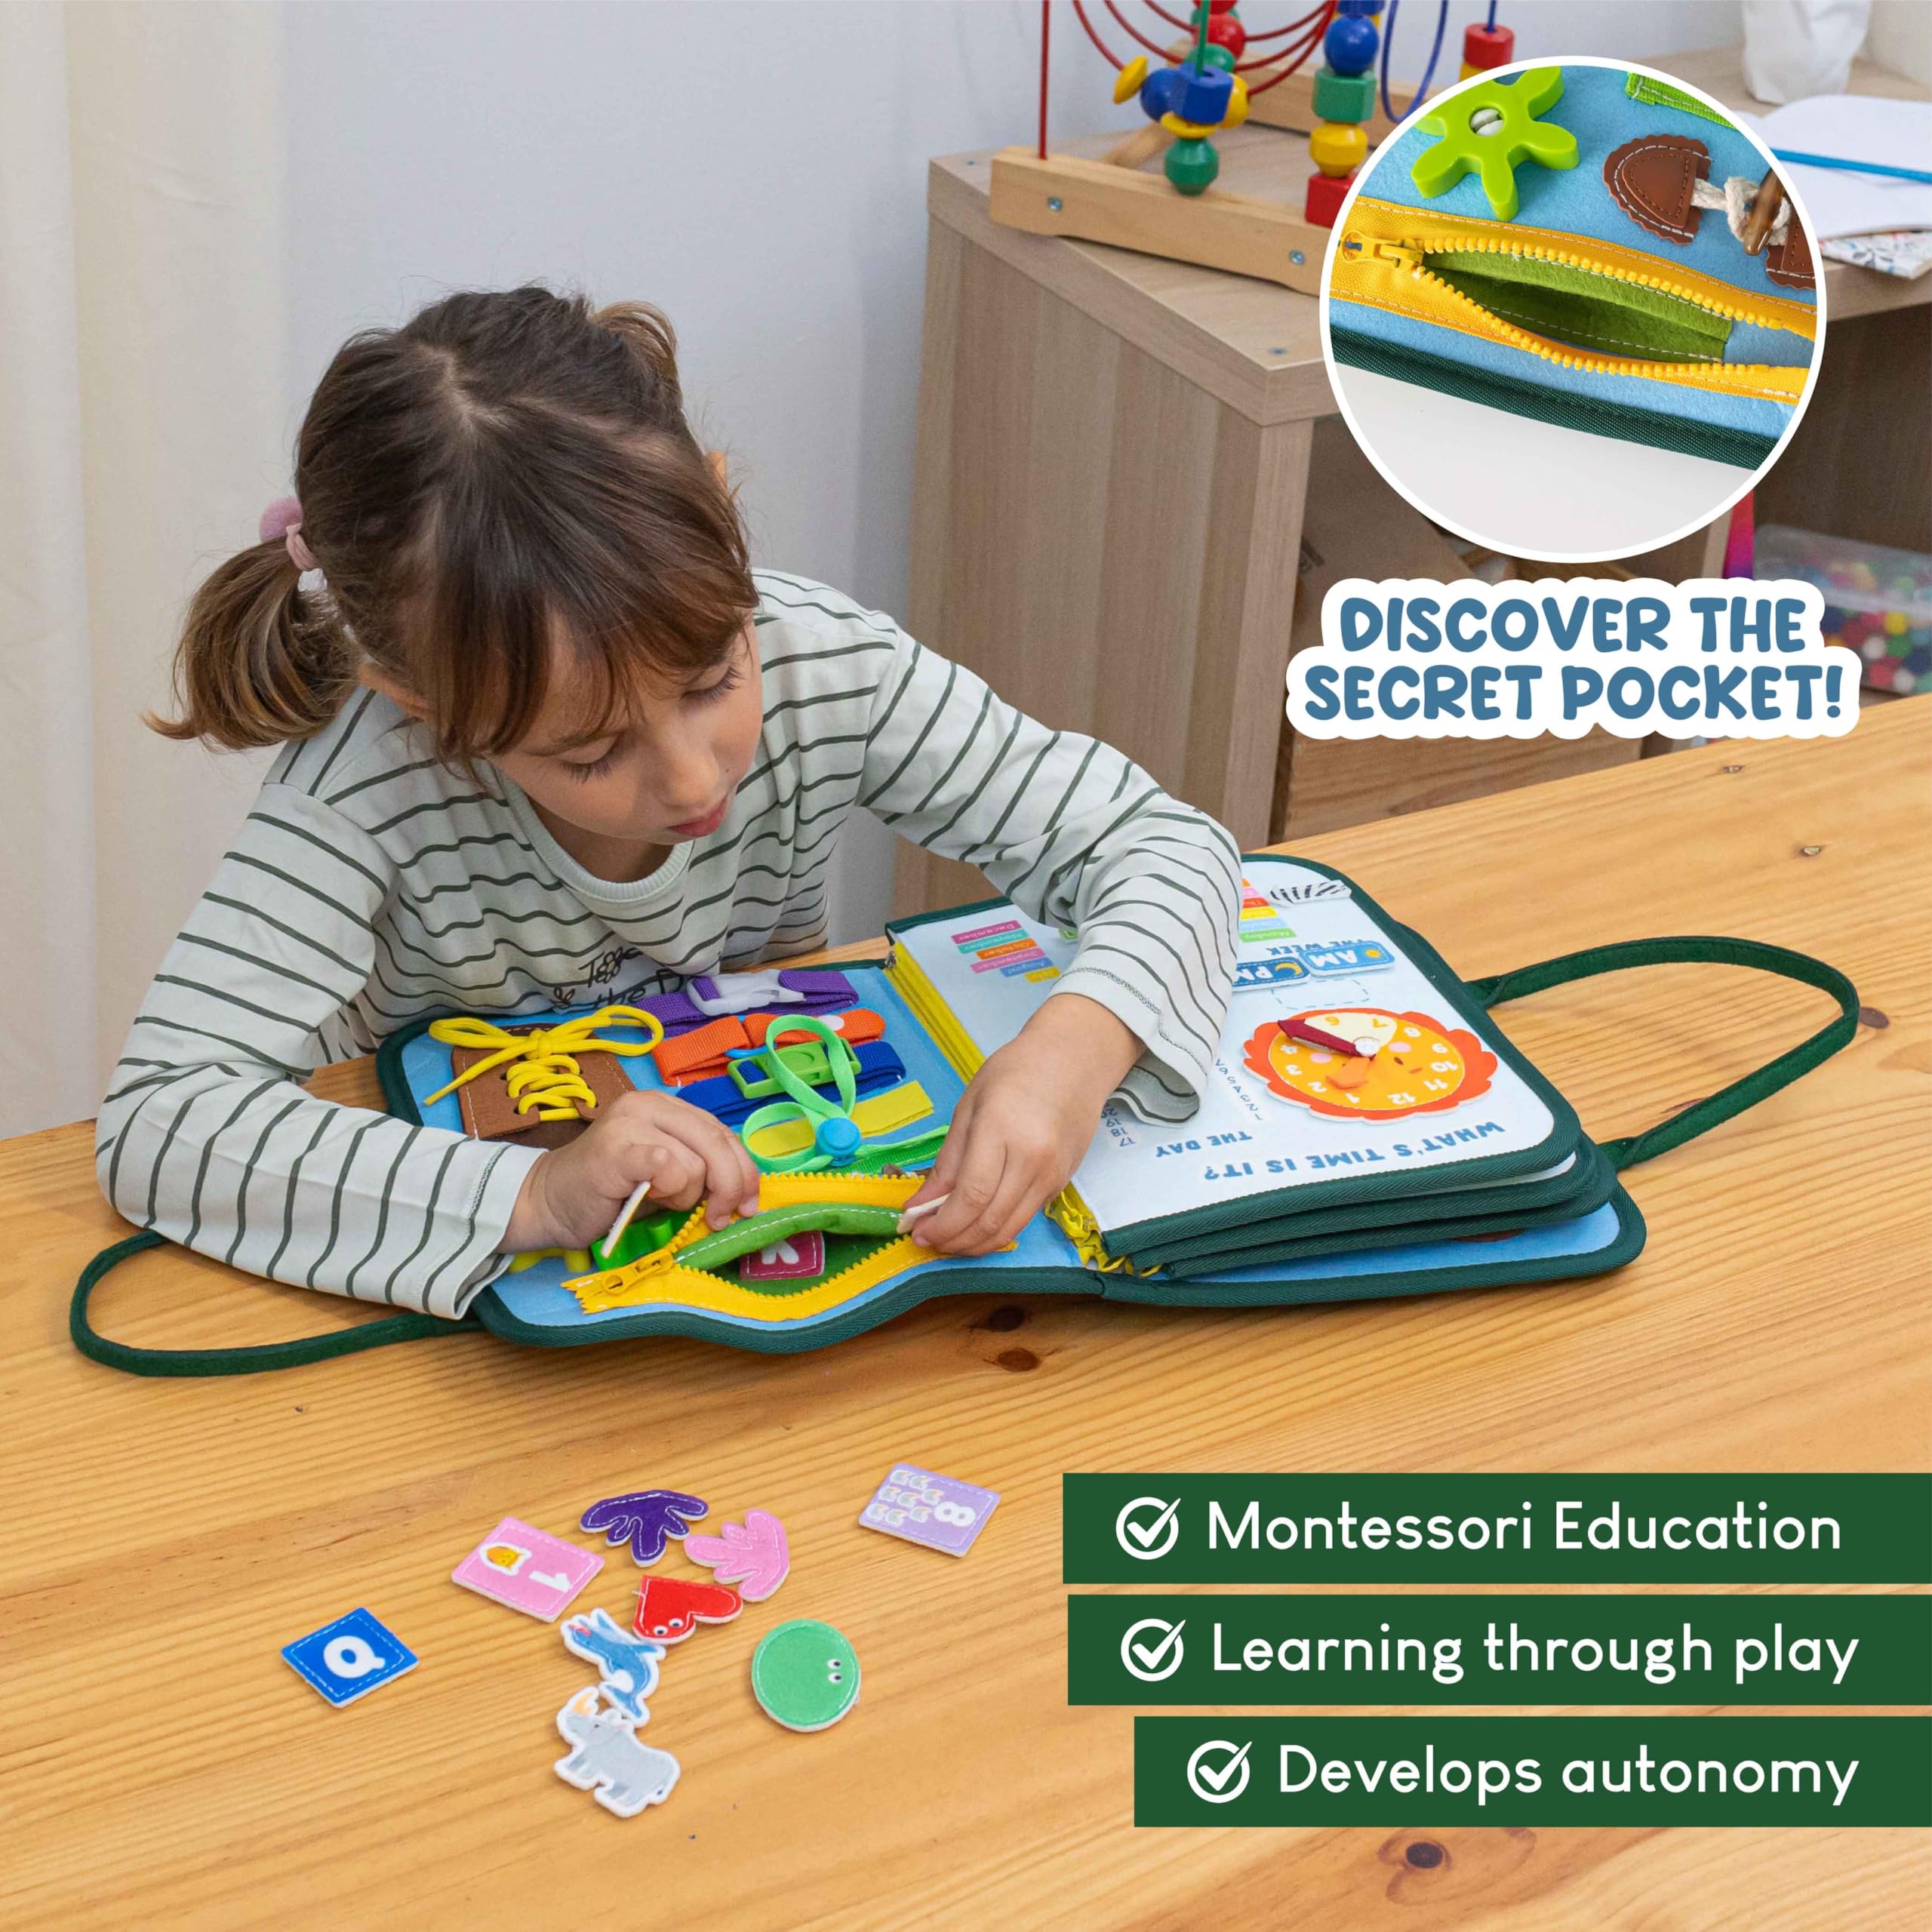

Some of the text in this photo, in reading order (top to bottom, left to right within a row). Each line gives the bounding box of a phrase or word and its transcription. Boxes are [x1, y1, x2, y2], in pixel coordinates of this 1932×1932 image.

[958, 924, 1014, 940] December
[983, 943, 1030, 957] October
[1308, 949, 1358, 968] AM
[1233, 966, 1273, 984] PM
[1324, 1016, 1340, 1026] 6
[1372, 1017, 1388, 1028] 7
[1404, 1026, 1421, 1038] 8
[1280, 1044, 1297, 1055] 4
[1431, 1043, 1448, 1054] 9
[1285, 1064, 1303, 1075] 3
[1430, 1061, 1458, 1072] 10
[1308, 1081, 1327, 1093] 2
[1423, 1078, 1448, 1091] 11
[1345, 1092, 1360, 1104] 1
[1387, 1092, 1416, 1105] 12
[1106, 1118, 1122, 1128] 19
[1111, 1128, 1128, 1137] 18
[1120, 1137, 1135, 1147] 17
[1156, 1131, 1253, 1157] THE DAY
[1204, 1121, 1504, 1180] WHAT'S TIME IS IT?
[934, 1501, 976, 1527] 8
[529, 1570, 571, 1592] 1
[323, 1635, 386, 1679] Q
